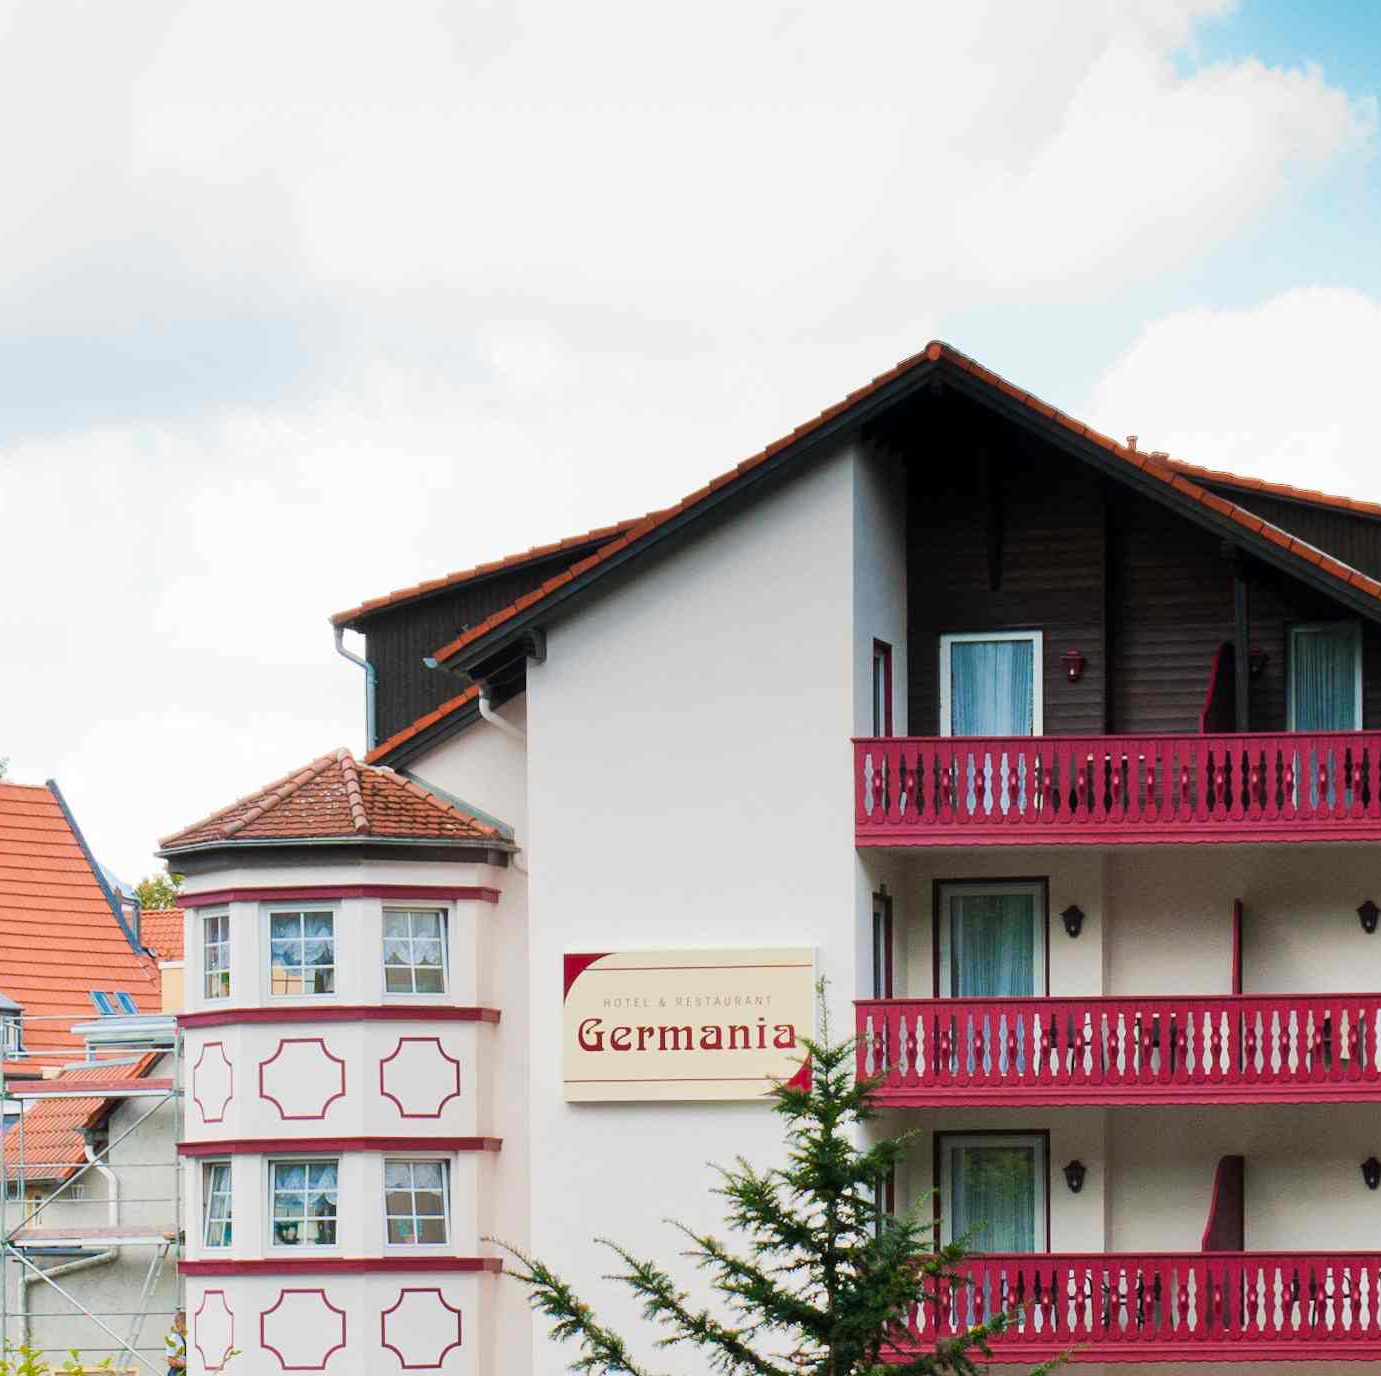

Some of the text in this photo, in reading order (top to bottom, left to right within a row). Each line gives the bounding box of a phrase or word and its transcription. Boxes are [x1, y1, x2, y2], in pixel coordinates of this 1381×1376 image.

[603, 995, 772, 1009] HOTEL & RESTAURANT
[578, 1017, 797, 1051] Germania
